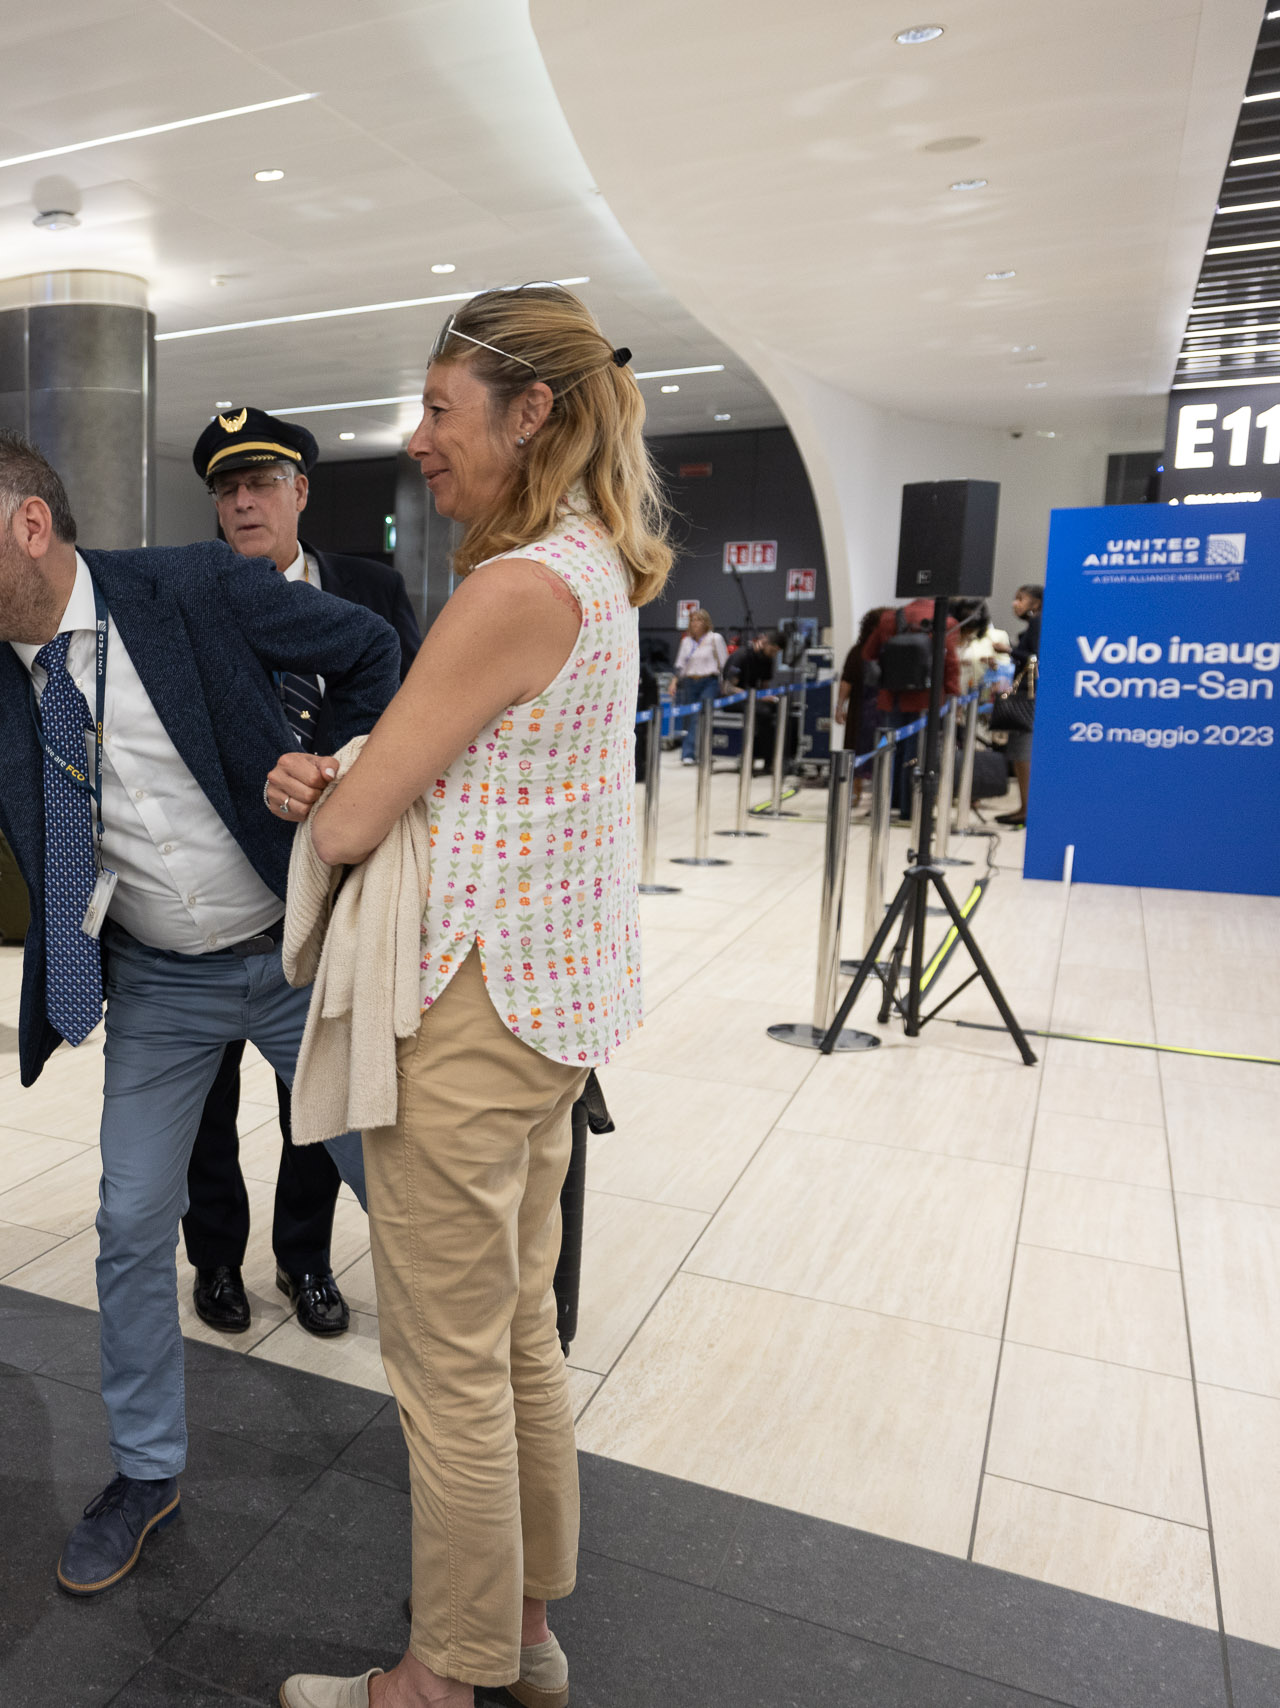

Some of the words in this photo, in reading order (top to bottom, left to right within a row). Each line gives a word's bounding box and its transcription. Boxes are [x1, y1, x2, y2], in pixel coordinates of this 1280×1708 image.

[1175, 403, 1280, 469] E11
[1082, 551, 1199, 567] AIRLINES
[1107, 537, 1200, 552] UNITED
[1077, 635, 1163, 665] Volo
[1169, 635, 1280, 672] inaug
[1074, 670, 1274, 700] Roma-San
[1070, 722, 1104, 743] 26
[1106, 725, 1200, 749] maggio
[1203, 725, 1274, 747] 2023
[45, 744, 55, 758] We
[54, 755, 67, 768] are
[65, 764, 86, 782] FCO
